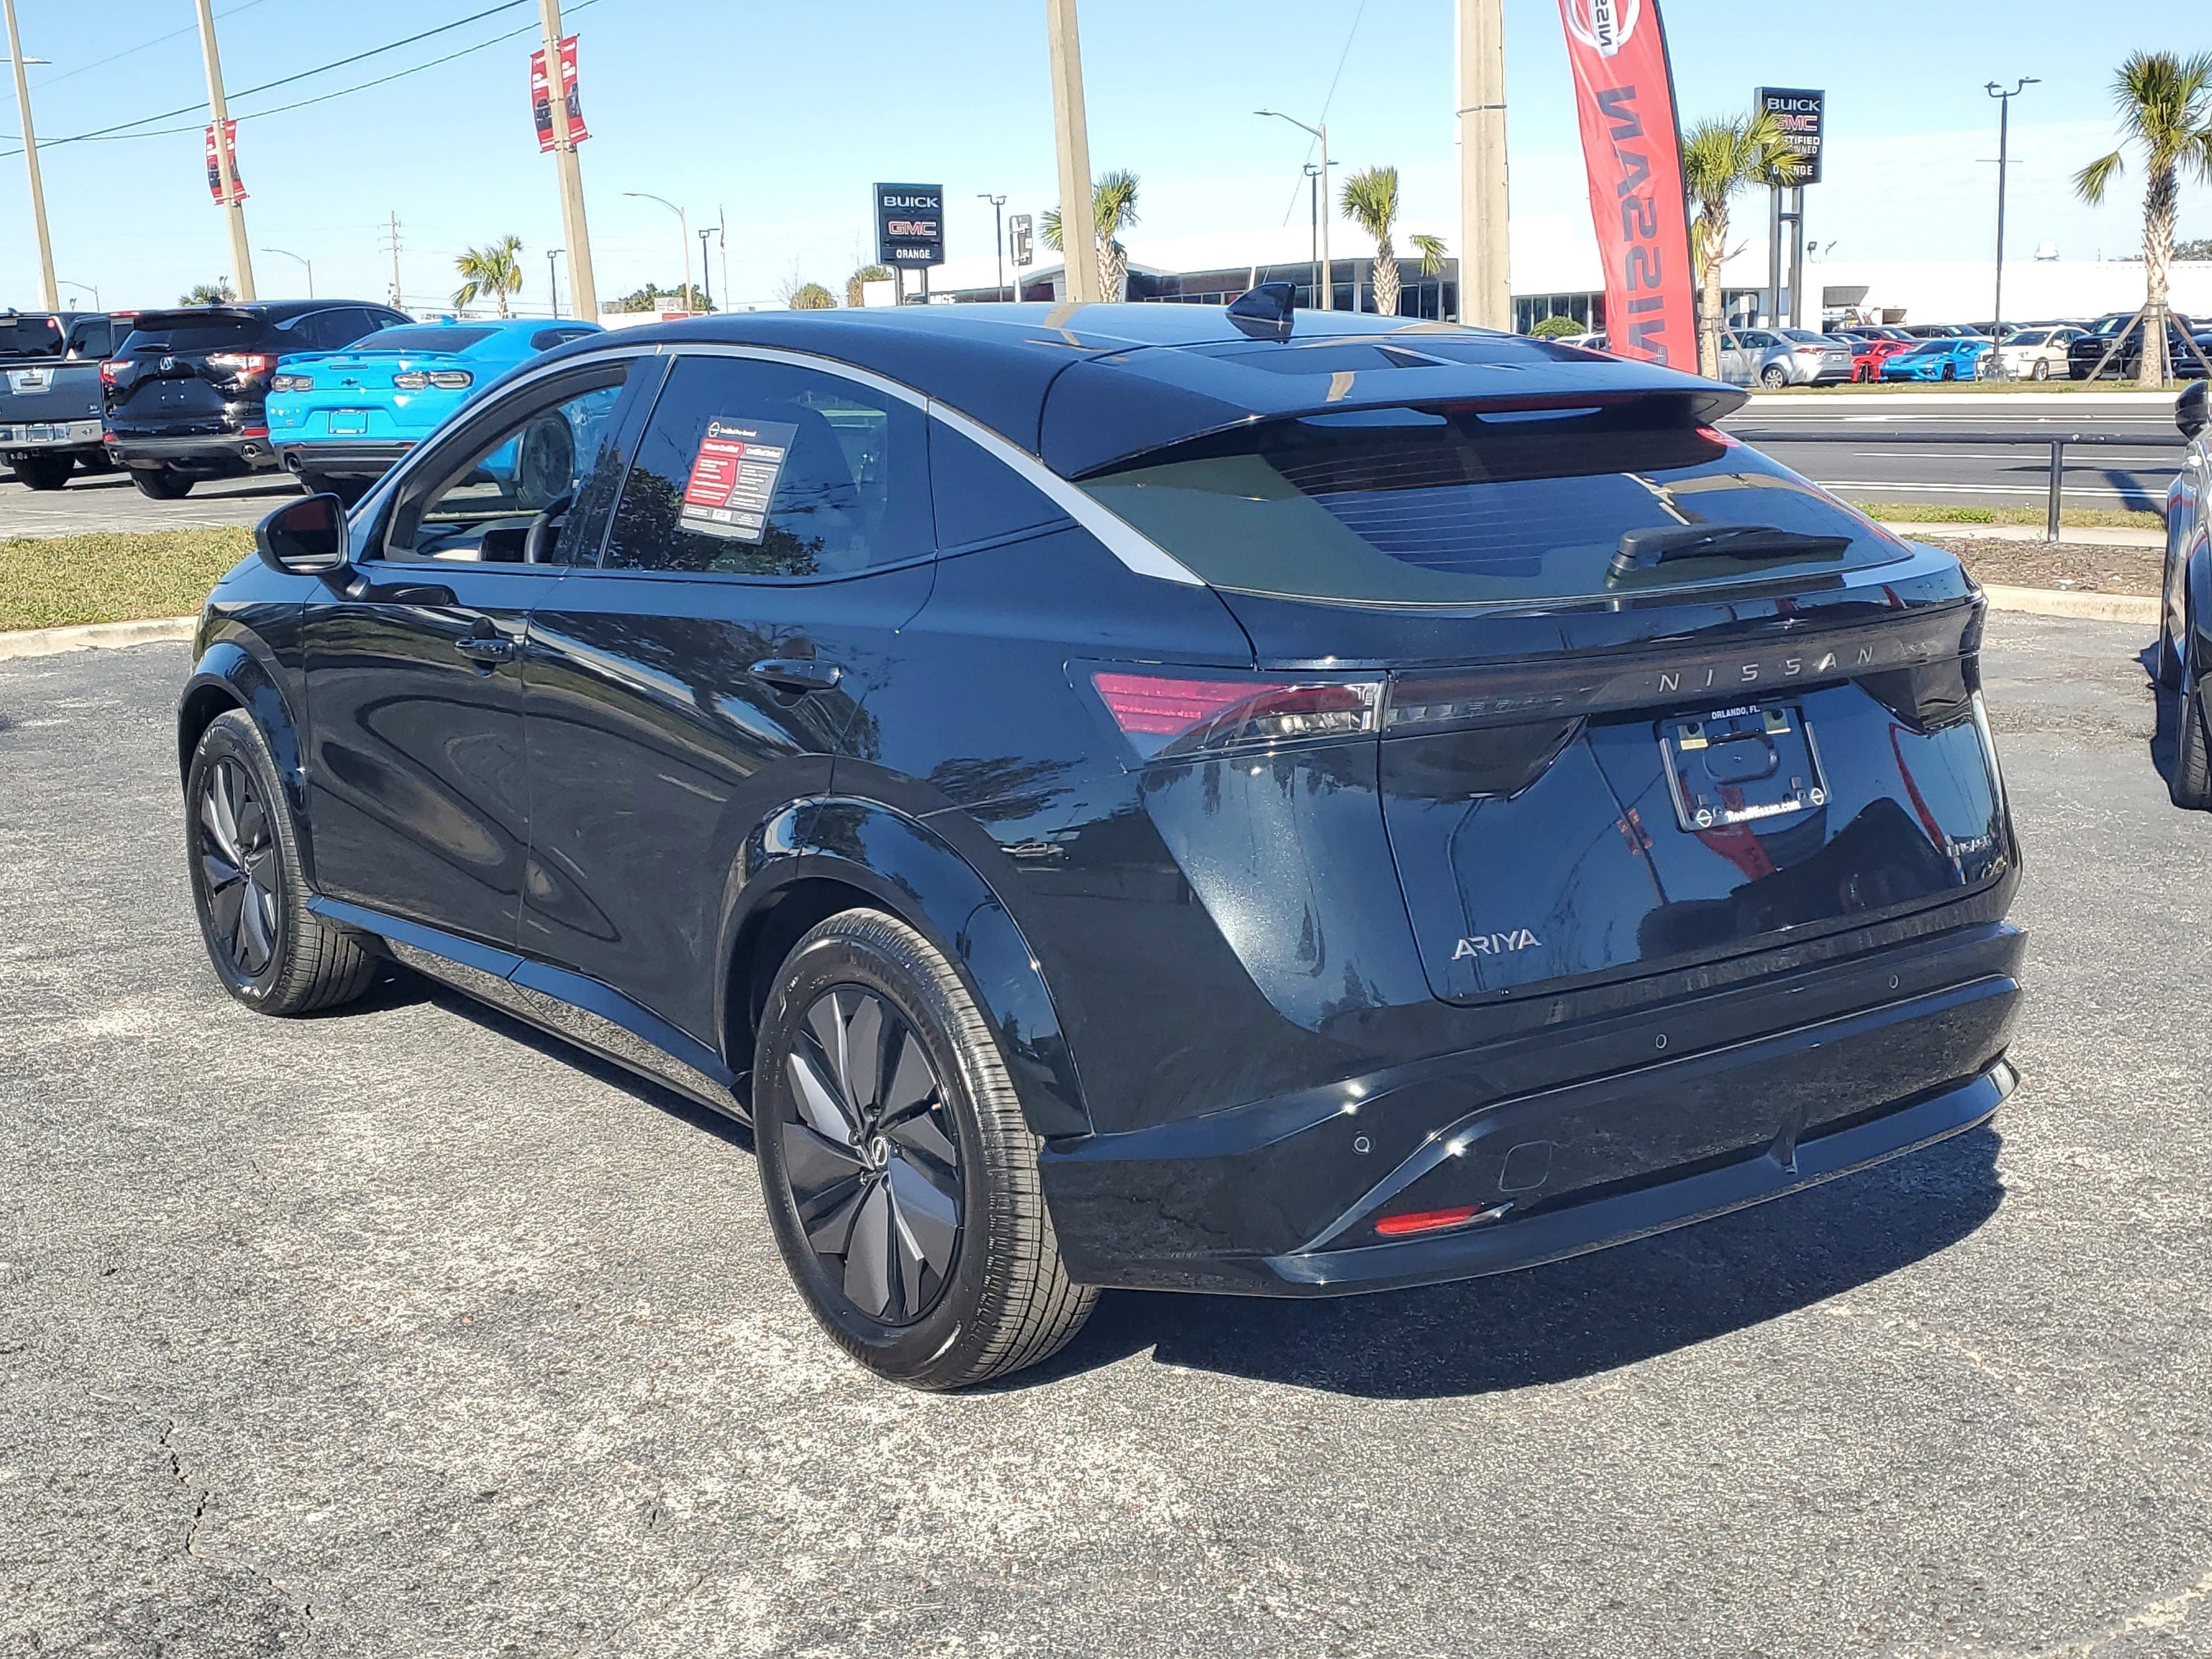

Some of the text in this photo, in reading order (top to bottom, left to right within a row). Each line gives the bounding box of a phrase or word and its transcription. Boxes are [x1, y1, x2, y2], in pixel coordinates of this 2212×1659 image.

[1767, 98, 1820, 112] BUICK
[1773, 165, 1814, 176] ONGE
[884, 195, 940, 208] BUICK
[888, 221, 936, 236] GMC
[896, 249, 931, 259] ORANGE
[1658, 645, 1873, 693] NISSAN
[1711, 706, 1748, 720] ORLANDO,
[1451, 928, 1543, 961] ARIYA
